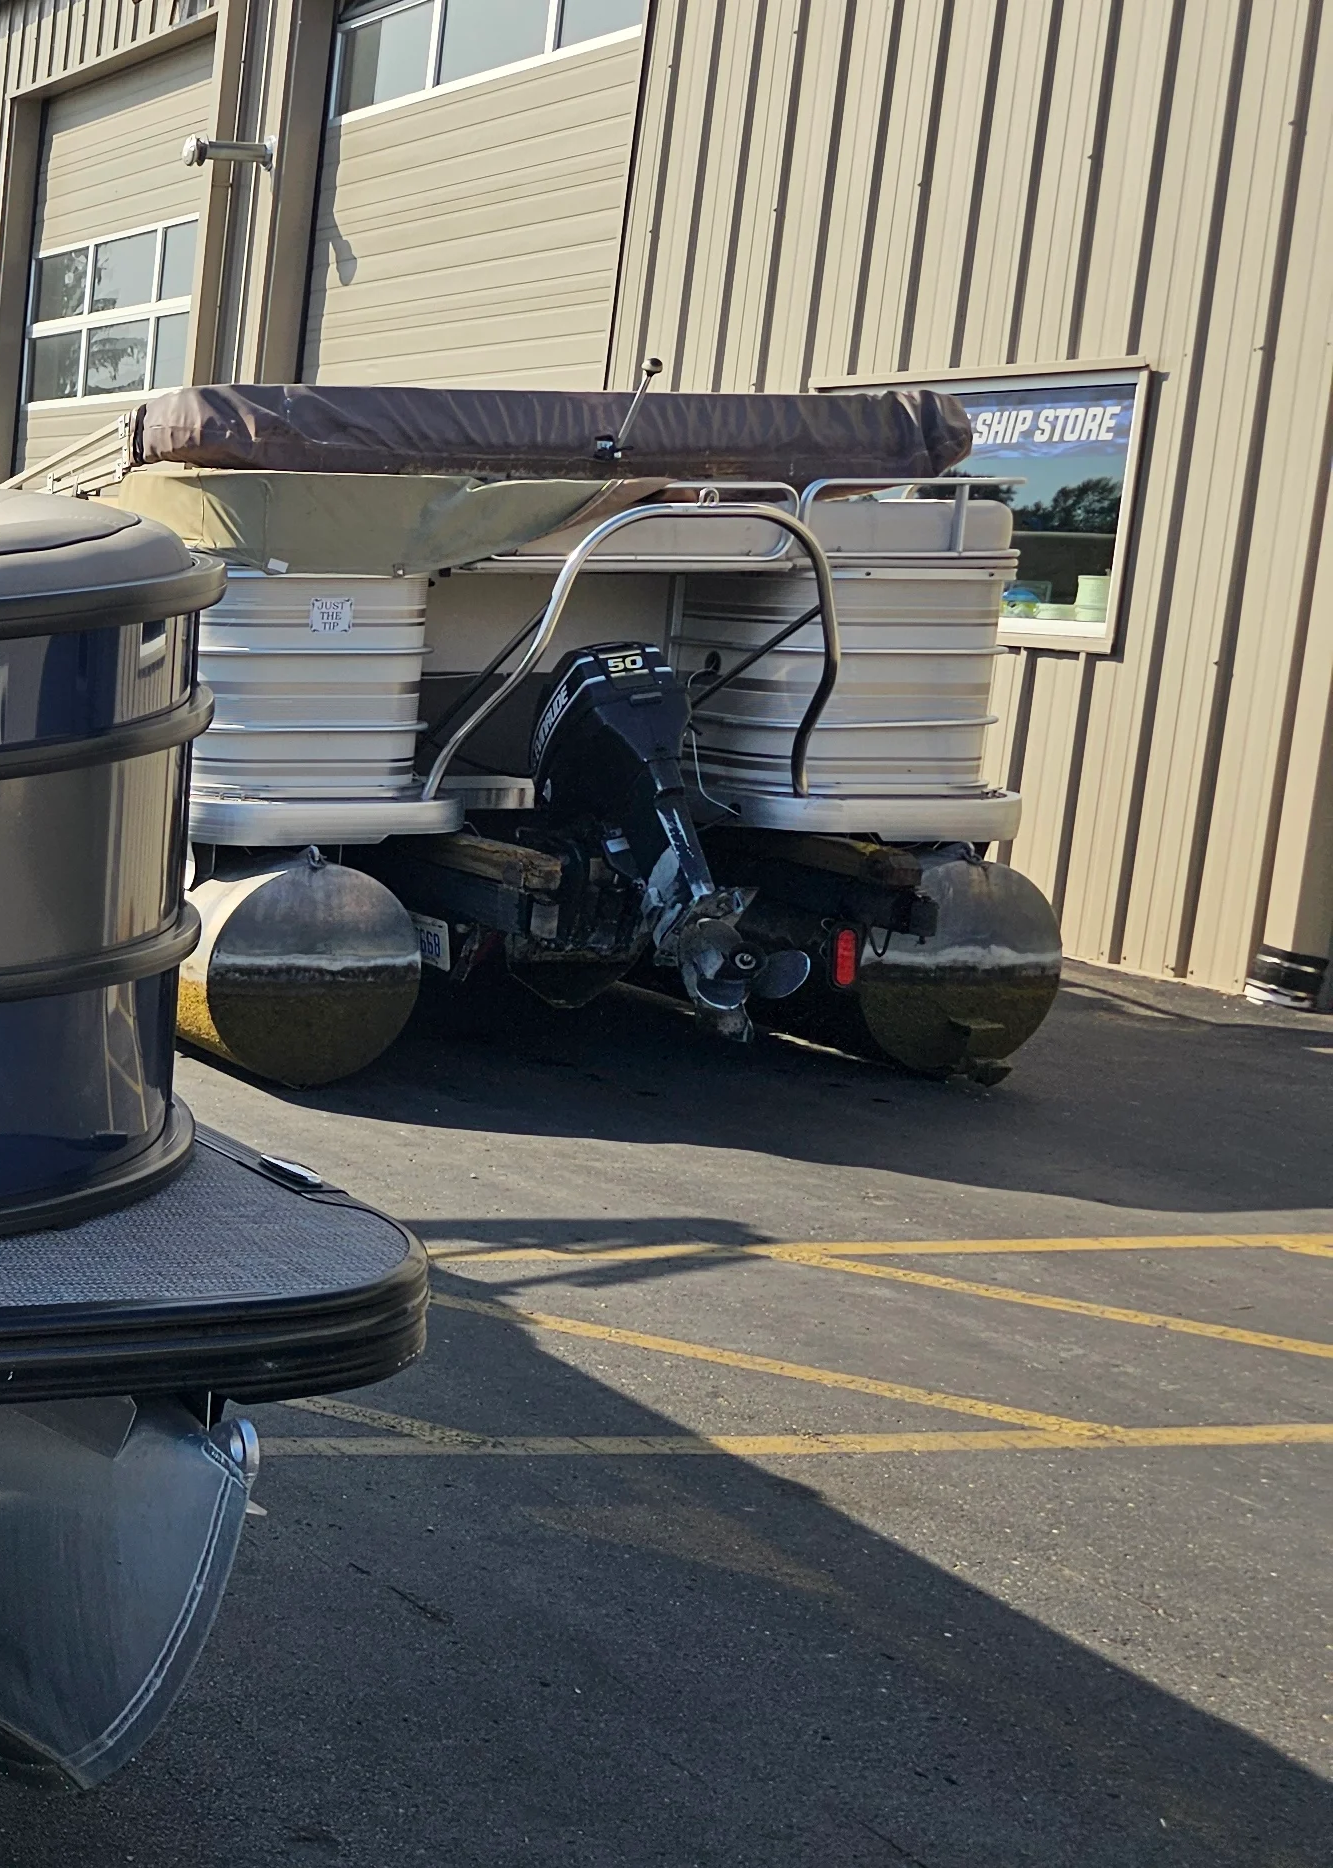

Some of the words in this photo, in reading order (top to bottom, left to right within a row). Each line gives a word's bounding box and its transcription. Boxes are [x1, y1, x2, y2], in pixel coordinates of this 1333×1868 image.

[972, 409, 1033, 445] SHIP
[1034, 405, 1121, 443] STORE
[317, 601, 345, 610] JUST
[320, 611, 342, 620] THE
[322, 621, 339, 630] TIP
[607, 655, 643, 672] 50
